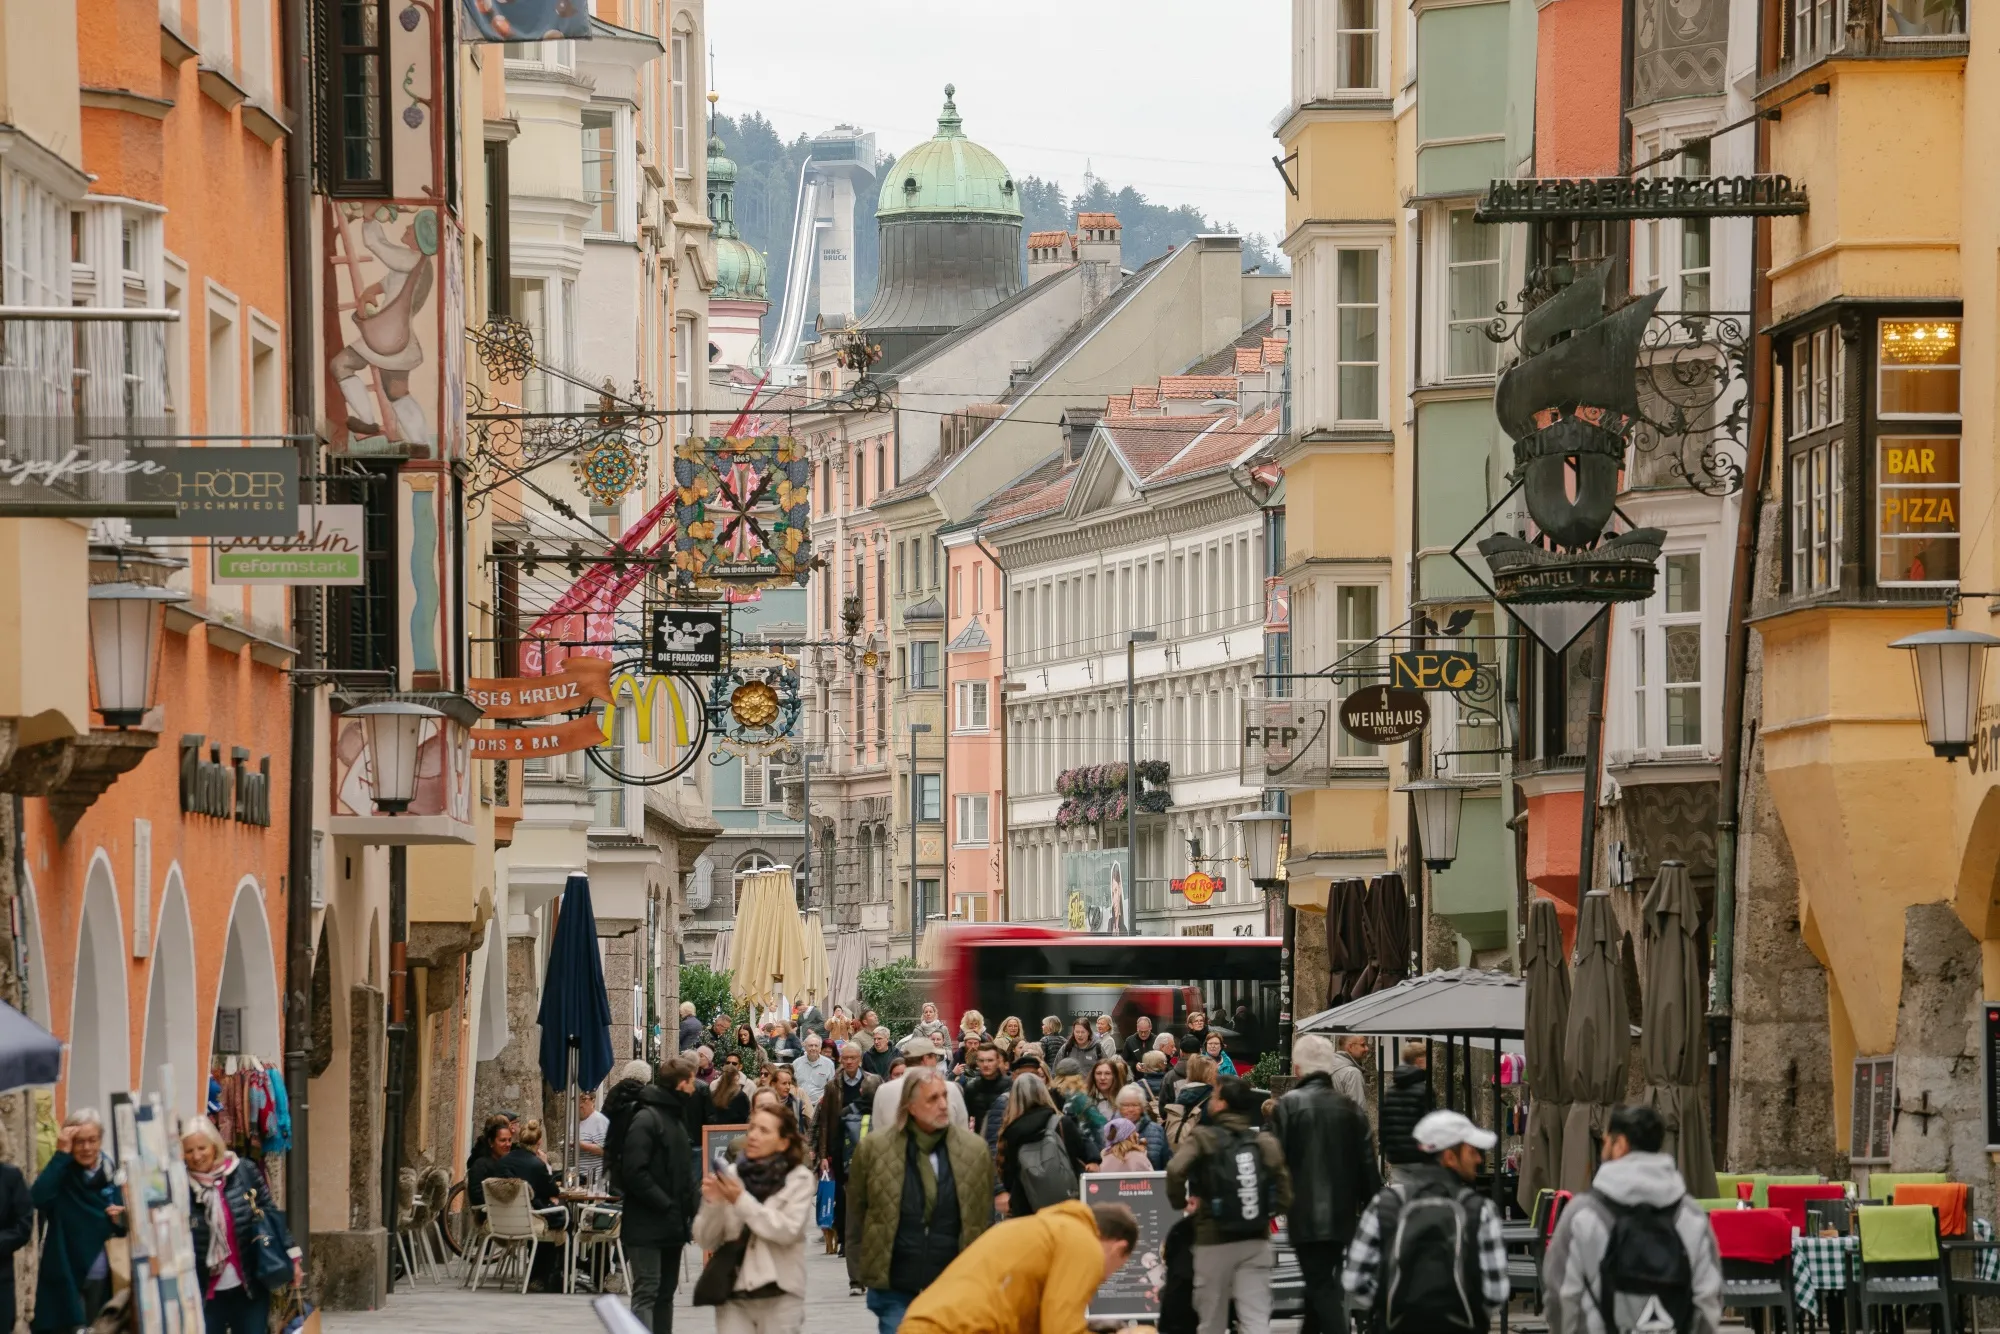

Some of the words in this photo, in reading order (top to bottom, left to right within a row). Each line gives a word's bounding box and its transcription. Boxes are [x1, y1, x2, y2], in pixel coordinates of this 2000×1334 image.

[733, 454, 750, 463] 1665
[1888, 449, 1935, 474] BAR
[143, 468, 285, 497] SCHRÖDER
[181, 502, 285, 510] DSCHMIEDE
[1886, 498, 1954, 523] PIZZA
[230, 558, 348, 573] reformstark
[731, 566, 755, 574] weißen
[658, 653, 671, 661] DIE
[672, 654, 714, 662] FRANZOSEN
[1391, 655, 1475, 689] NEO
[520, 682, 580, 704] KREUZ
[1348, 709, 1423, 728] WEINHAUS
[1246, 727, 1298, 747] FFP
[1373, 726, 1399, 735] TYROL
[515, 738, 523, 750] &
[532, 735, 559, 749] BAR
[1171, 879, 1197, 892] Hard
[1199, 877, 1223, 892] Rock
[1235, 1152, 1259, 1220] adidas
